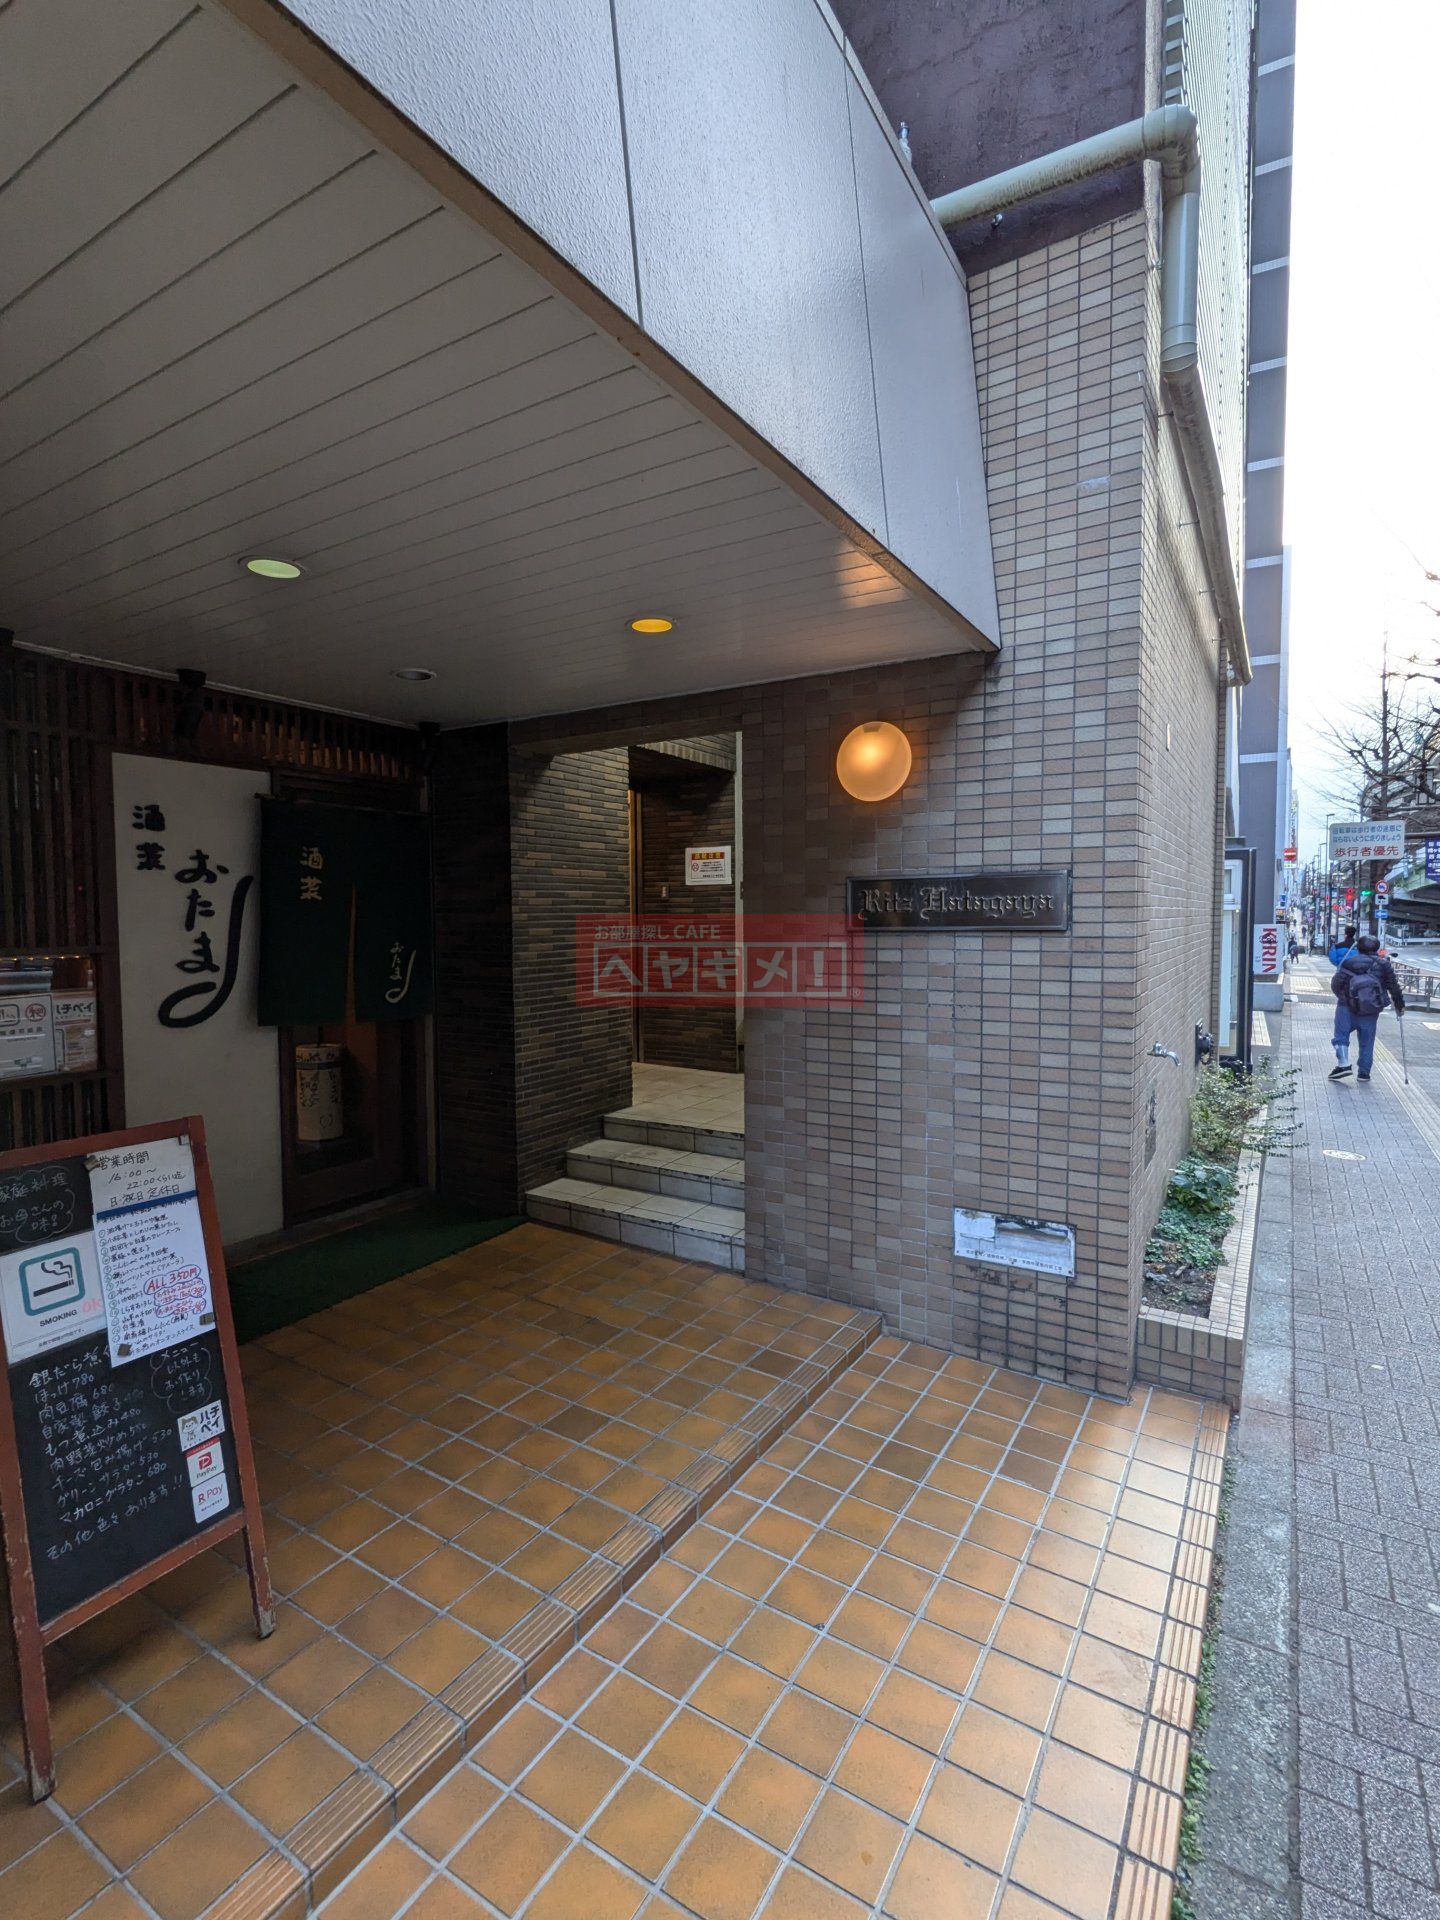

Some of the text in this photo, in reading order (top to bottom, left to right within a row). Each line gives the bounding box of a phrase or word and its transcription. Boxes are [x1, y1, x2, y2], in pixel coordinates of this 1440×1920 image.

[131, 802, 167, 872] 酒菜
[1335, 846, 1399, 857] 歩行者優先
[298, 845, 325, 902] 酒菜
[858, 886, 1055, 922] Ritz Hatagaya
[1262, 928, 1277, 972] KIRIN
[98, 1150, 150, 1170] 営業時間
[147, 1277, 168, 1293] ALL
[39, 1309, 77, 1327] SMOKING
[161, 1342, 199, 1358] メニュー
[72, 1373, 95, 1388] 780
[139, 1452, 159, 1466] 530
[147, 1462, 167, 1477] 680
[196, 1463, 217, 1480] PayPay
[206, 1484, 223, 1498] Pay
